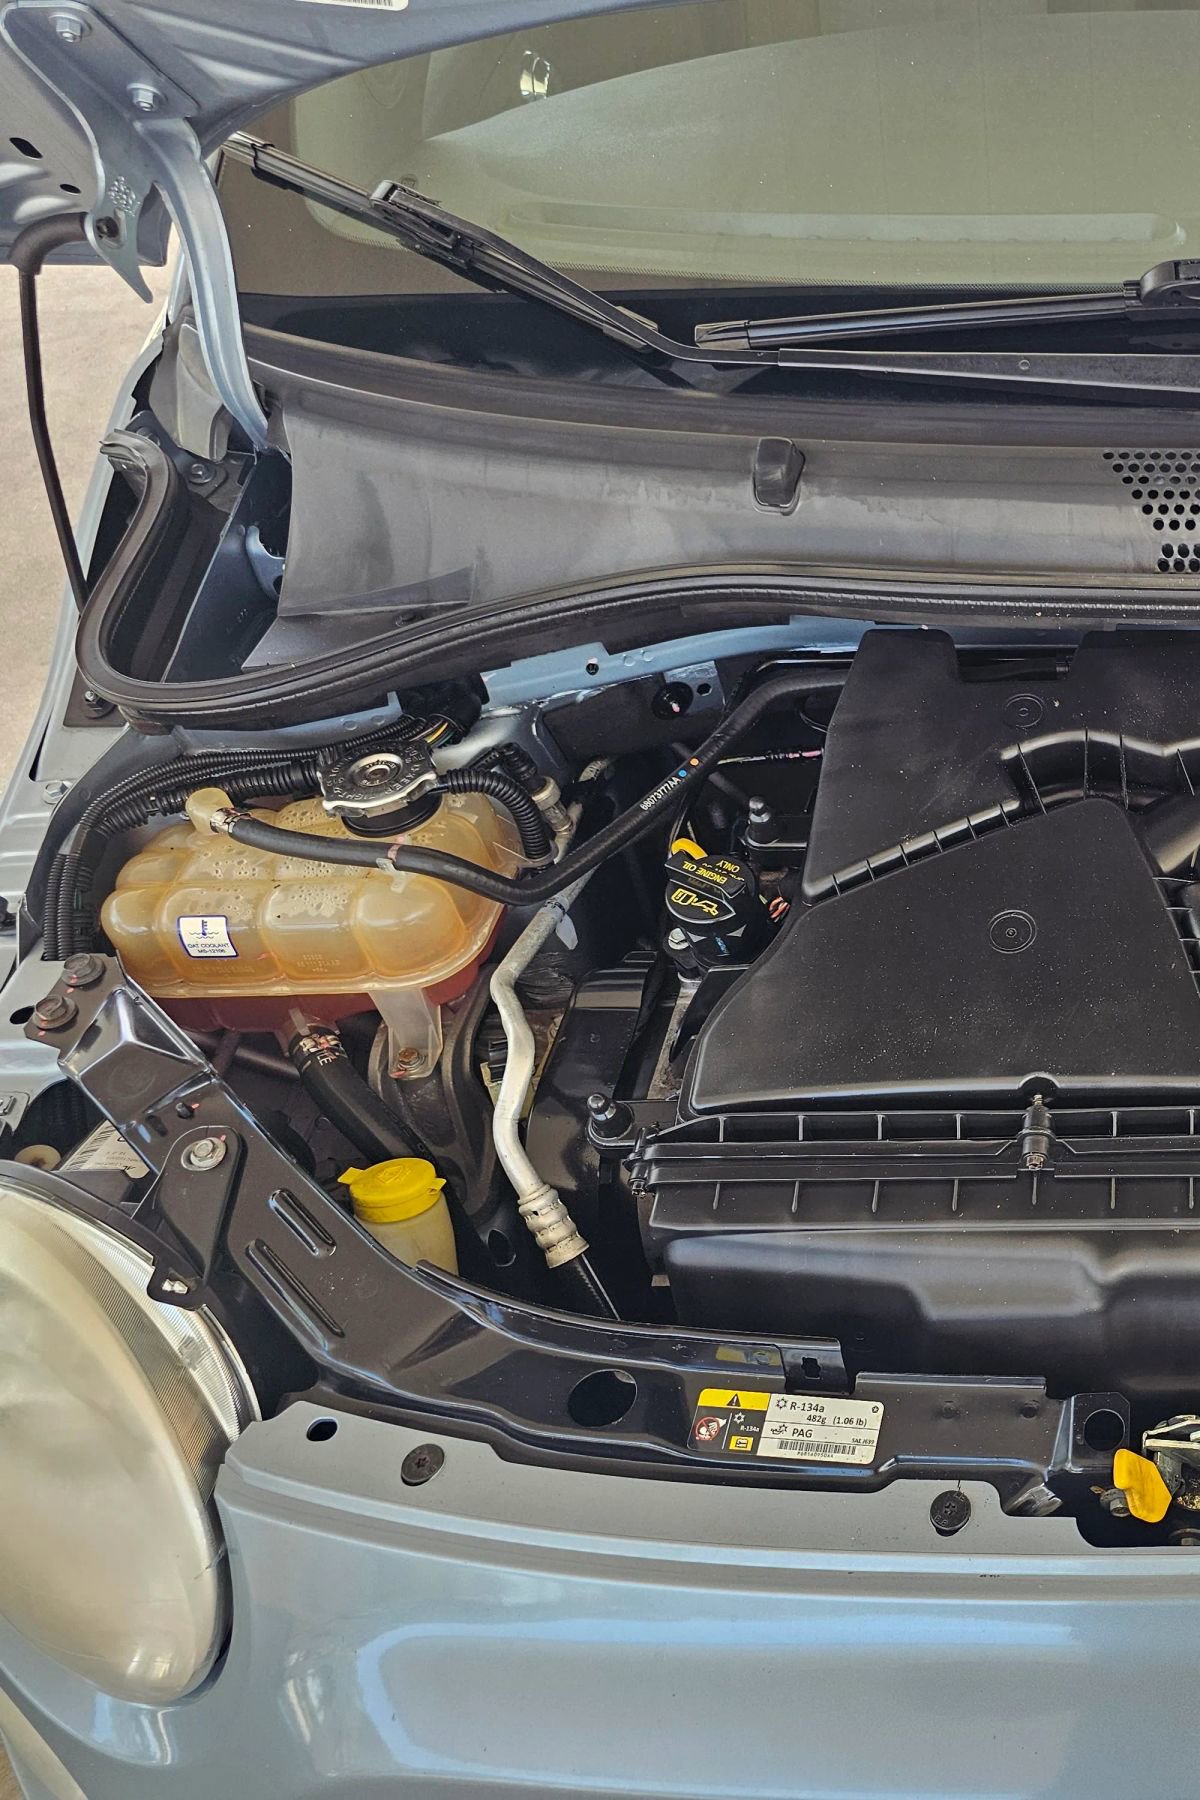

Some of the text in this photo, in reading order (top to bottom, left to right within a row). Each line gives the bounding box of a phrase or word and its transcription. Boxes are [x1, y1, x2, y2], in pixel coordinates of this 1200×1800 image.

[682, 860, 696, 872] OIL
[716, 860, 740, 872] ONLY
[696, 866, 728, 884] ENGINE
[790, 1402, 825, 1412] R-134a
[806, 1414, 867, 1427] 482g (1.06 lb)
[792, 1428, 813, 1438] PAG
